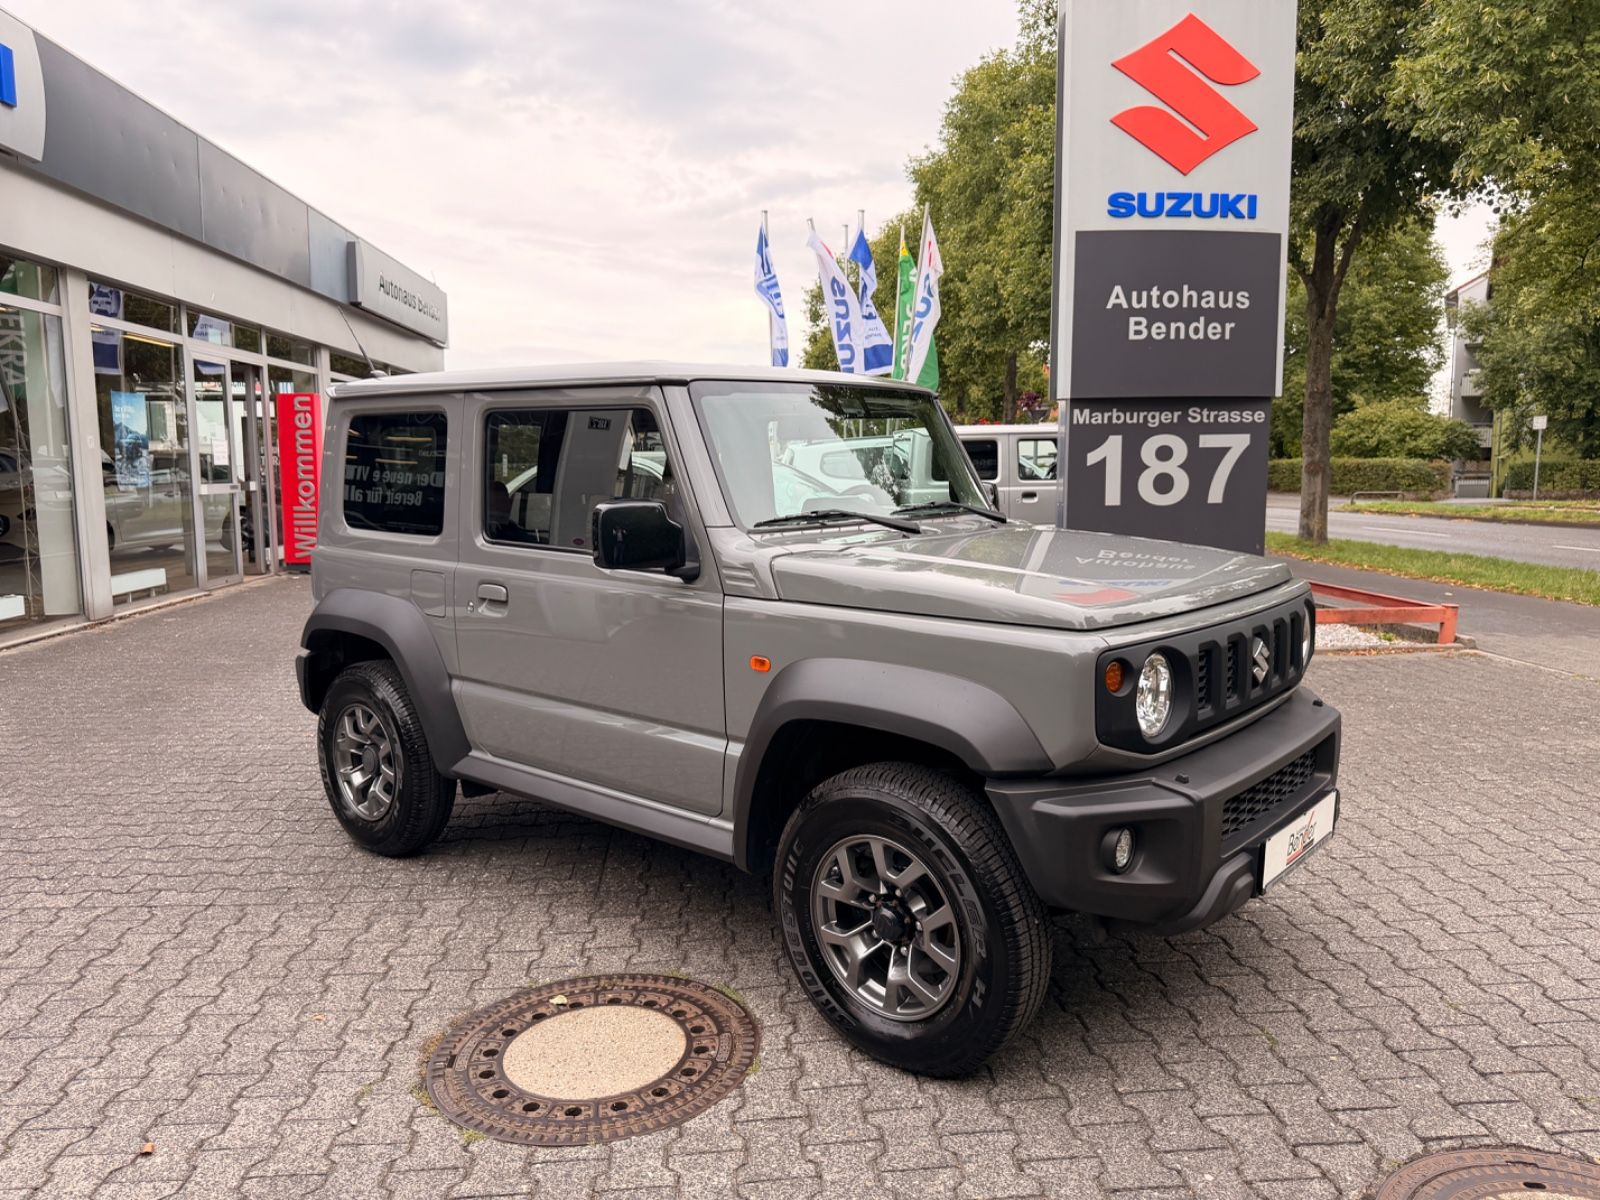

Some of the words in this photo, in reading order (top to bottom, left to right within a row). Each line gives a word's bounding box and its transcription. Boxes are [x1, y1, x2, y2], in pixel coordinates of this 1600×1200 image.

[1107, 192, 1258, 219] SUZUKI
[1106, 285, 1251, 309] Autohaus
[1128, 316, 1236, 341] Bender
[1072, 408, 1182, 427] Marburger
[1187, 407, 1266, 424] Strasse
[293, 396, 317, 558] Willkommen
[1086, 433, 1252, 507] 187
